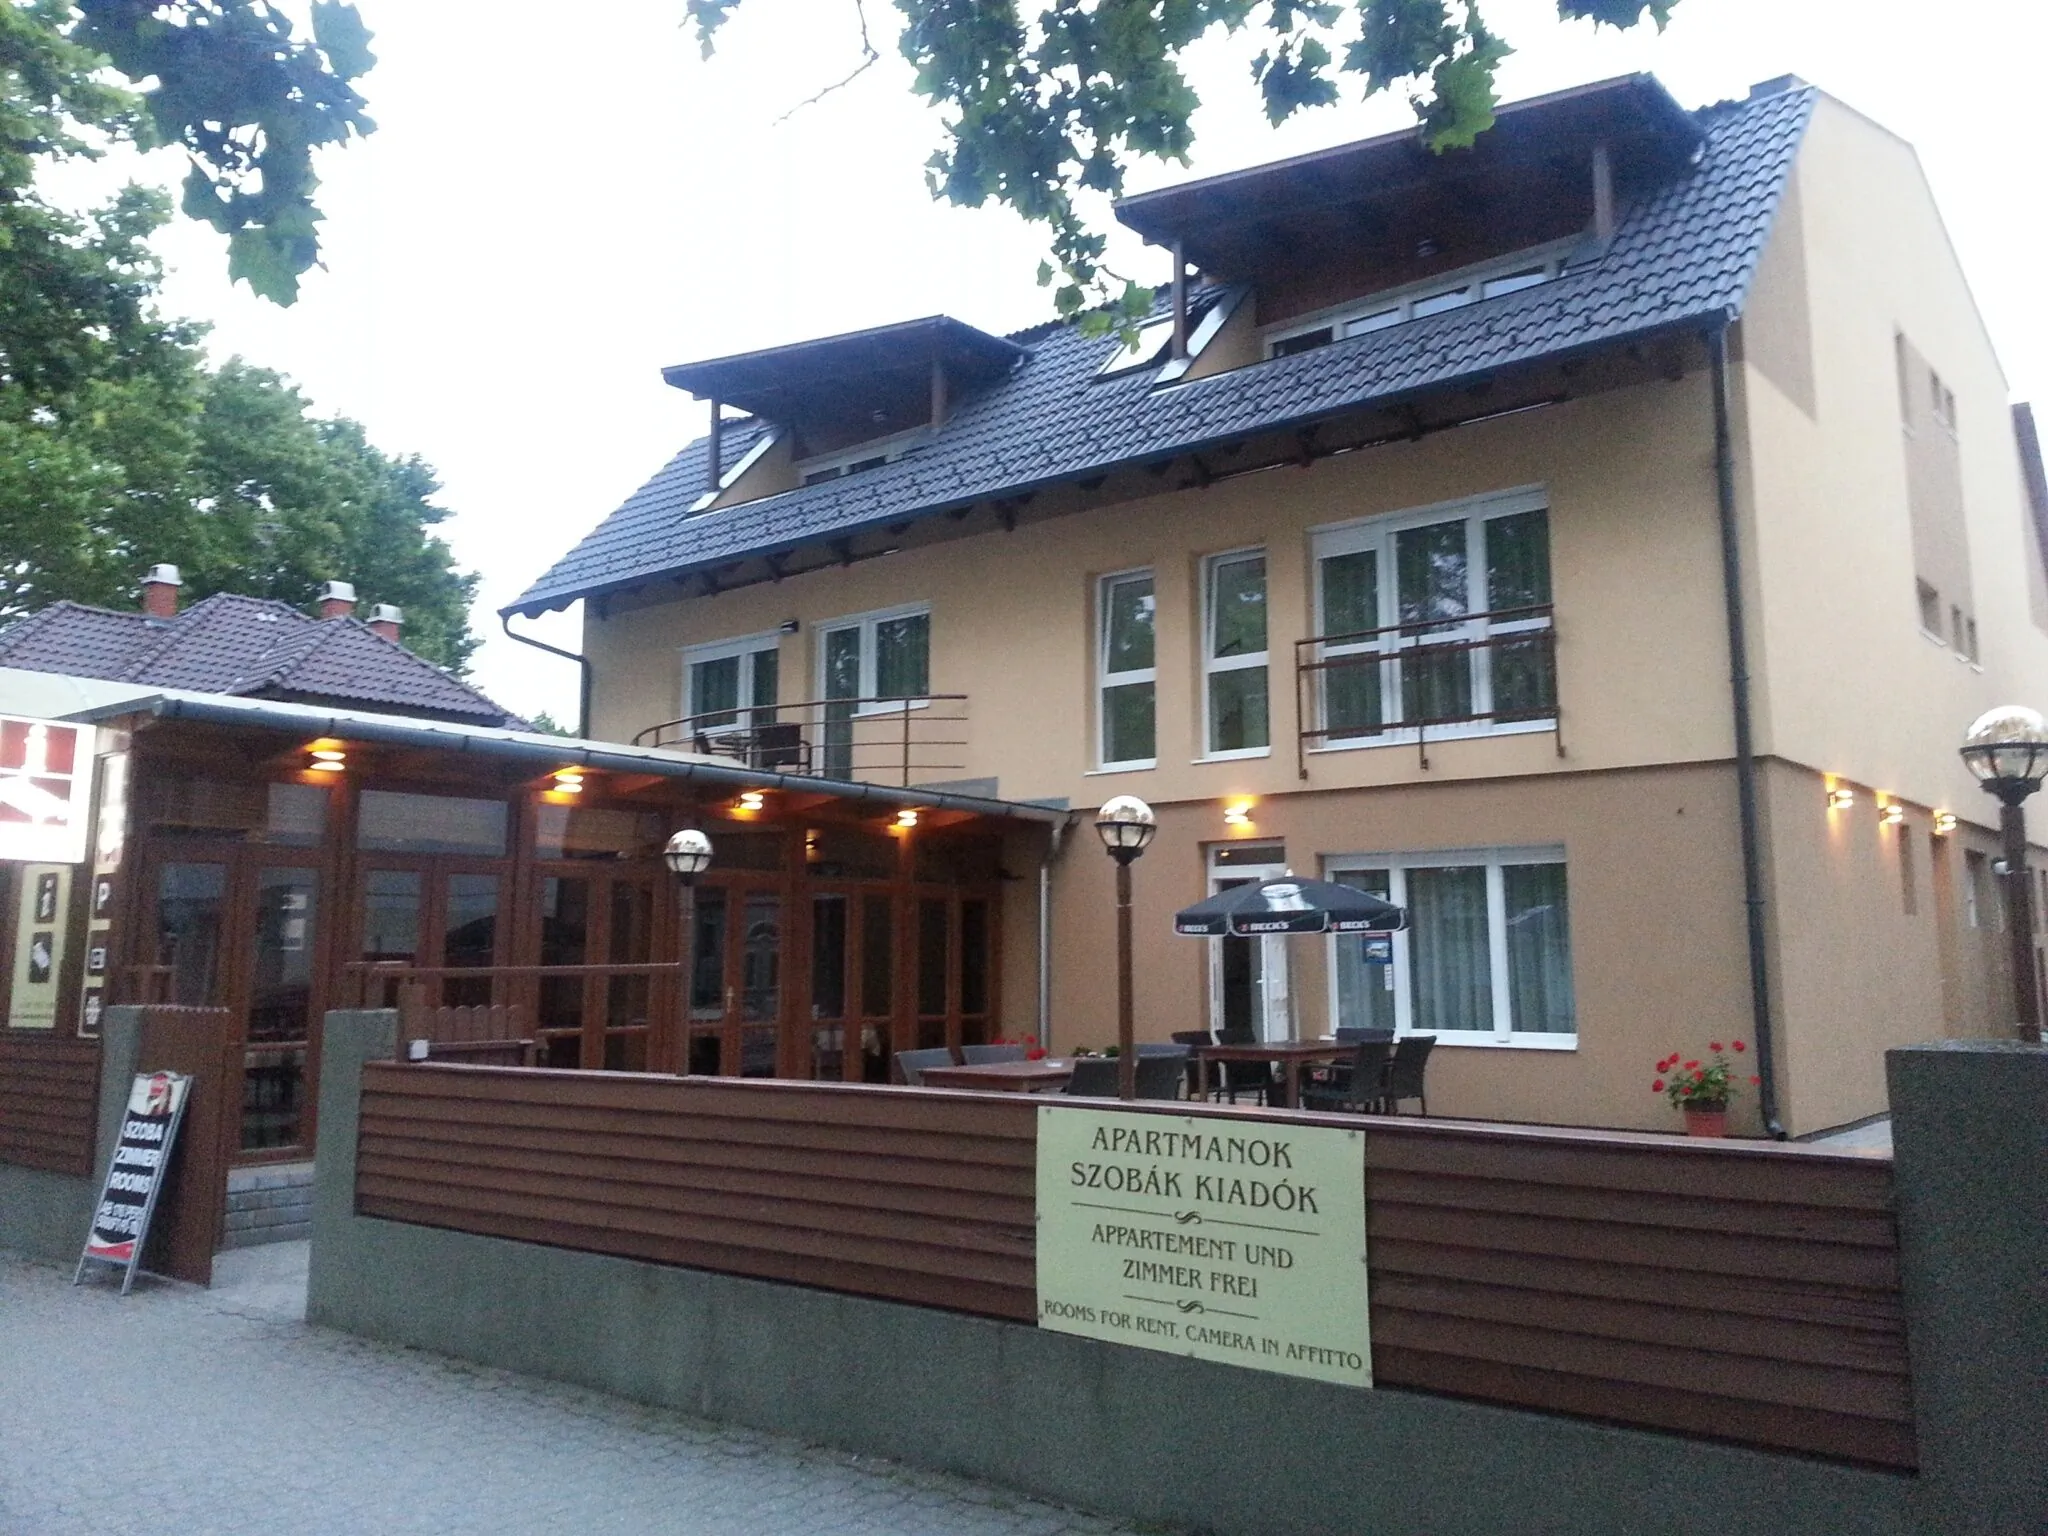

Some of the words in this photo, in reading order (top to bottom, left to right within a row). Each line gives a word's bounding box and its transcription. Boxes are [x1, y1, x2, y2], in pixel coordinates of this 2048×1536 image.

[97, 882, 111, 910] P
[1250, 921, 1289, 931] BECK'S
[1092, 1126, 1292, 1168] APARTMANOK
[109, 1171, 150, 1194] ROOMS
[1071, 1162, 1181, 1197] SZOBÁK
[1196, 1178, 1318, 1213] KIADÓK
[1092, 1224, 1236, 1260] APPARTEMENT
[1245, 1244, 1293, 1268] UND
[1123, 1260, 1202, 1289] ZIMMER
[1210, 1273, 1258, 1297] FREI
[1045, 1300, 1096, 1322] ROOMS
[1100, 1310, 1131, 1329] FOR
[1185, 1325, 1255, 1351] CAMERA
[1262, 1338, 1279, 1356] IN
[1286, 1342, 1362, 1370] AFFITTO
